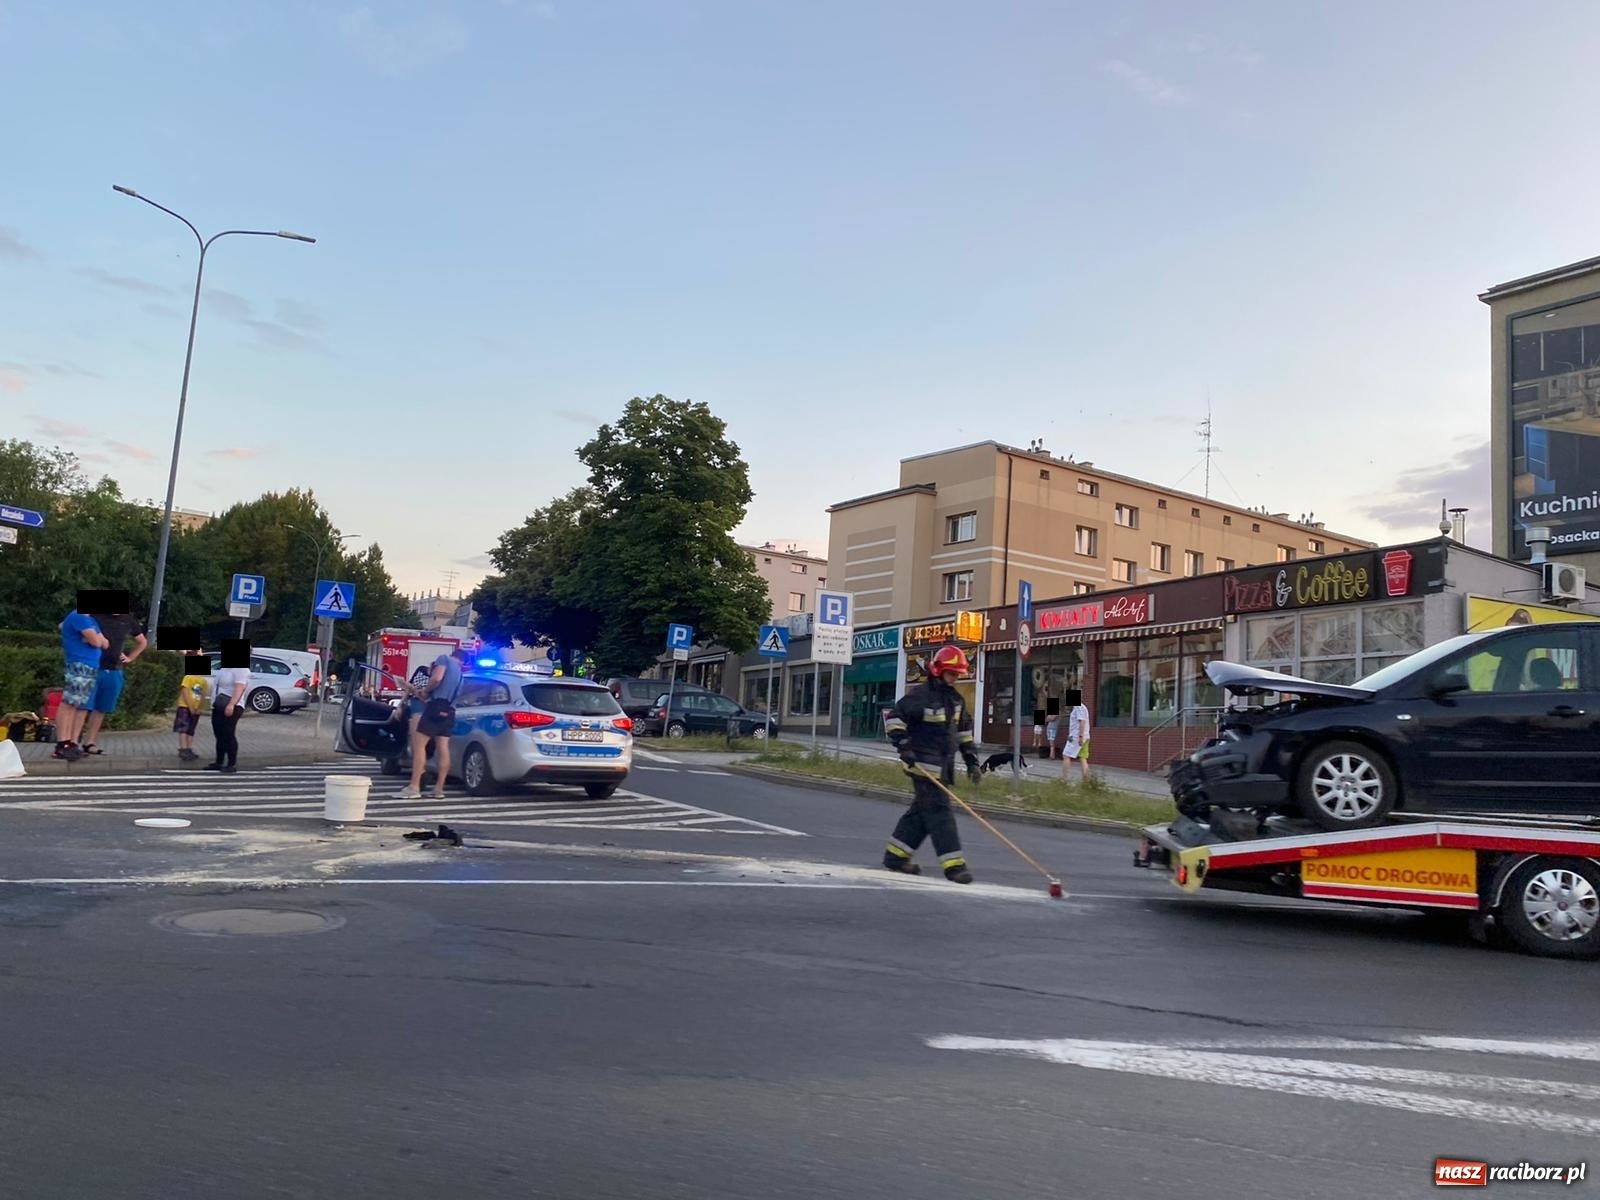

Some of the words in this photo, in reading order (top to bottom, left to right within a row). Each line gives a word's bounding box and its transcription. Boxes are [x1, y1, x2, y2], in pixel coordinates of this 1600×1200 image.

[1520, 490, 1600, 517] Kuchni
[238, 577, 257, 600] P
[1224, 575, 1272, 612] Pizza
[1275, 569, 1292, 607] &
[1296, 560, 1370, 605] Coffee
[825, 598, 842, 621] P
[1040, 605, 1101, 630] KWIATY
[673, 627, 687, 645] P
[853, 632, 886, 650] OSKAR
[914, 622, 956, 640] KEBA
[1306, 863, 1372, 881] POMOC
[1375, 867, 1472, 888] DROGOWA
